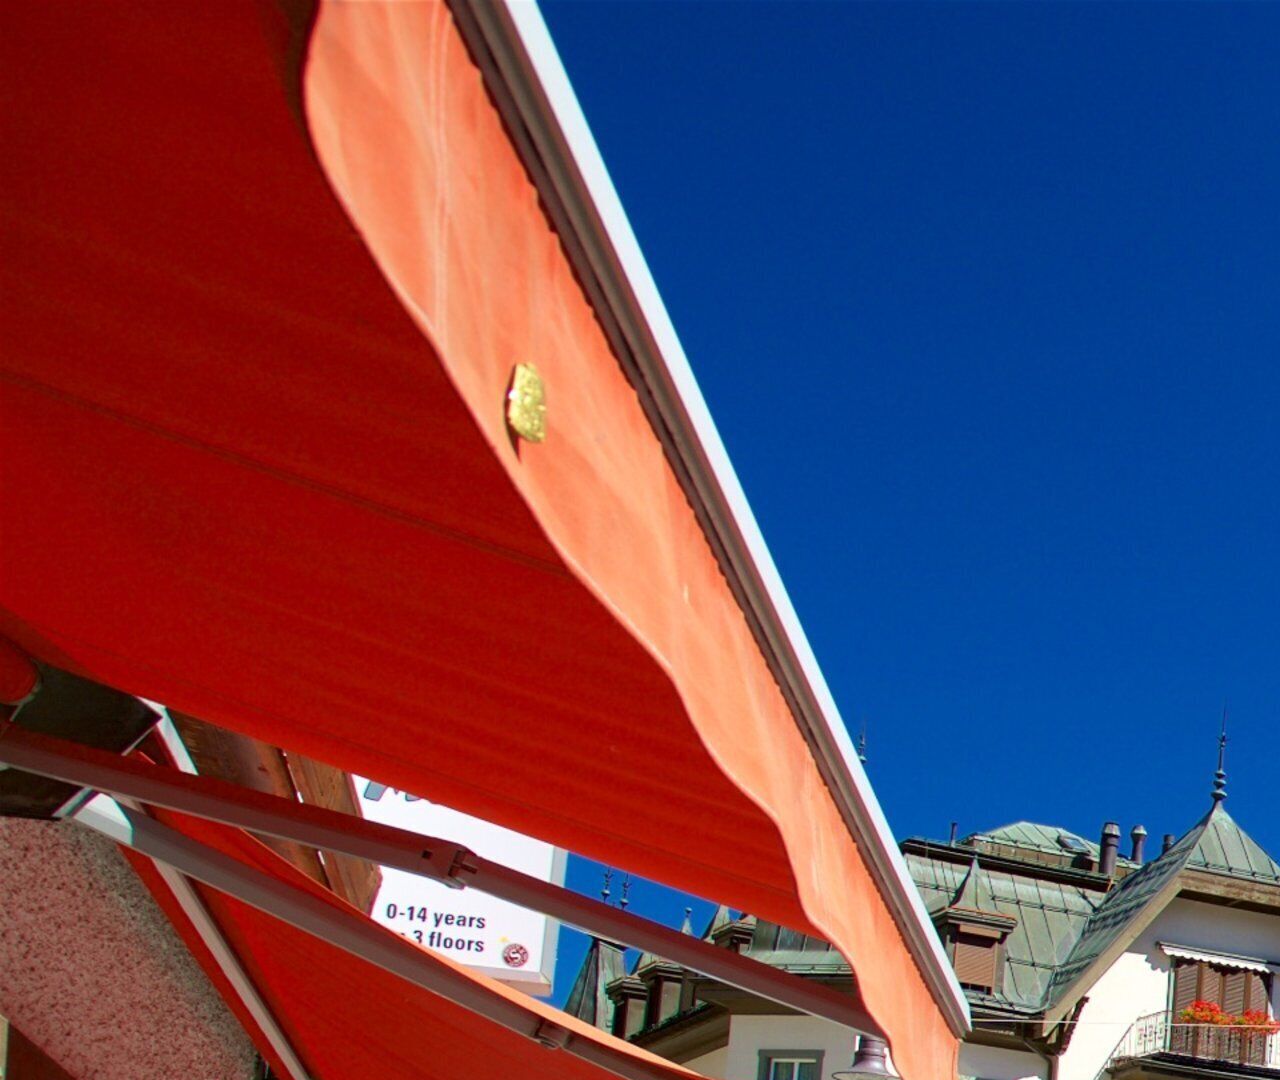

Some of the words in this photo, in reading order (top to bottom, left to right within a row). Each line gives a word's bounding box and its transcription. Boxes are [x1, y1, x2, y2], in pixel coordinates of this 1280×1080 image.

[386, 902, 427, 923] 0-14
[433, 910, 487, 930] years
[429, 931, 485, 953] floors
